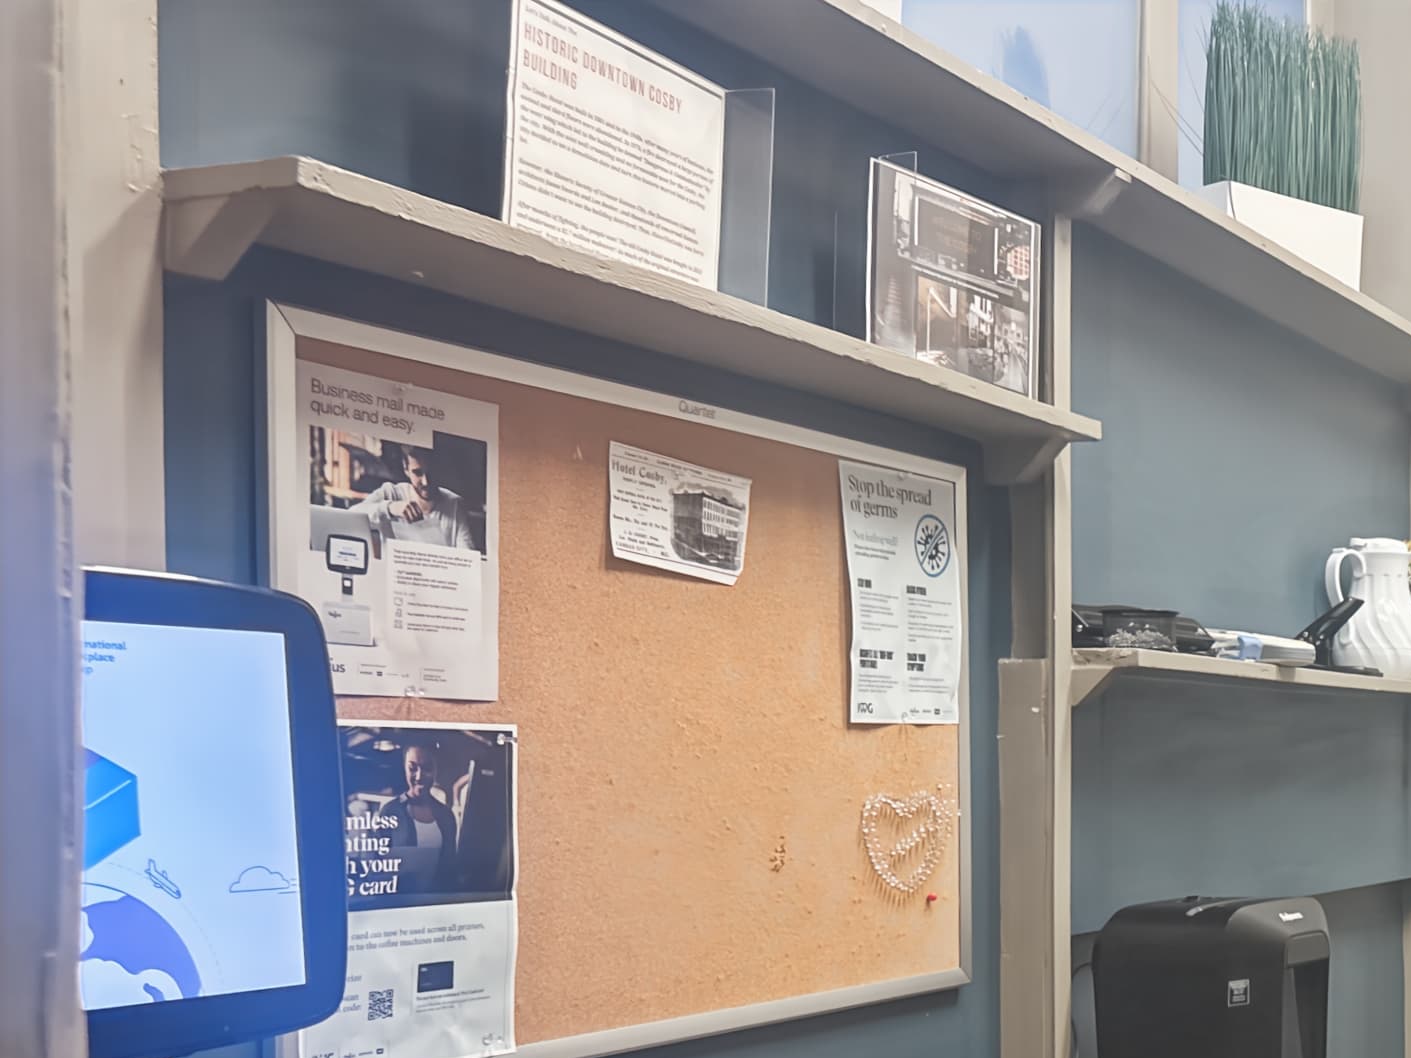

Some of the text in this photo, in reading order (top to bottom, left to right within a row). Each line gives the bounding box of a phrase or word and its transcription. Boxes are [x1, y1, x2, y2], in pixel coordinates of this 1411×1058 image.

[523, 48, 577, 90] BUILDING
[524, 22, 682, 113] HISTORIC DOWNTOWN COSBY
[311, 377, 446, 421] Business mail made
[310, 400, 415, 434] quick and easy.
[611, 459, 636, 476] Hotel
[848, 474, 932, 507] Stop the spread
[850, 494, 898, 519] of germs
[84, 641, 127, 650] national
[346, 811, 399, 831] mless
[346, 832, 390, 855] nting
[360, 858, 402, 878] your
[359, 875, 398, 896] card
